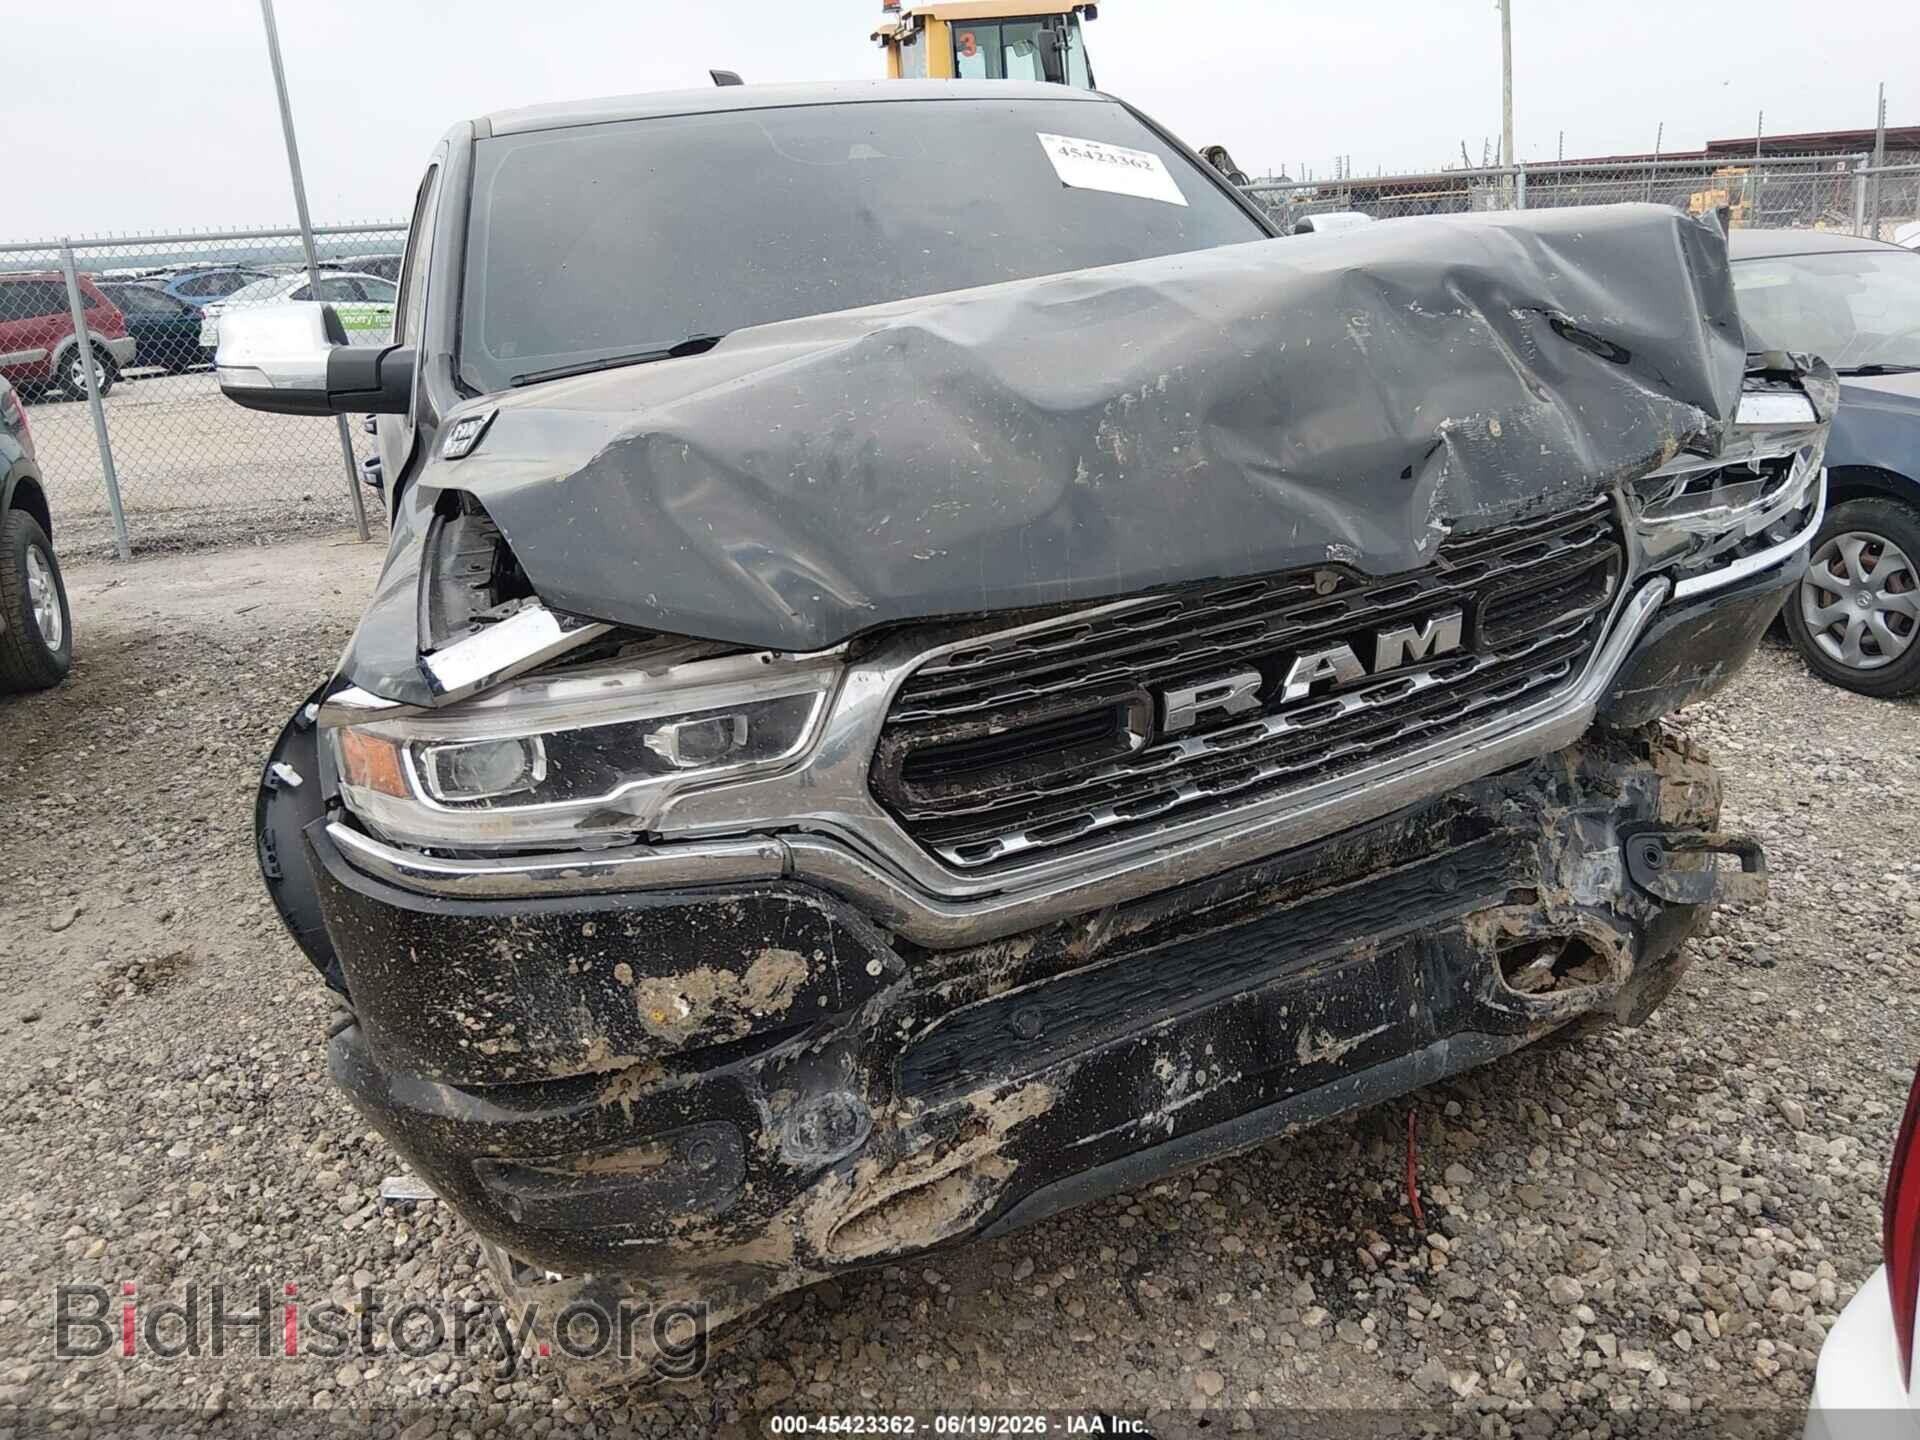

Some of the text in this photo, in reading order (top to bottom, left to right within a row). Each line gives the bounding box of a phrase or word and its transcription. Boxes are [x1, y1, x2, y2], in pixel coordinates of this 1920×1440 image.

[959, 31, 977, 57] 3
[1058, 145, 1155, 172] 45423362
[1162, 607, 1464, 732] RAM
